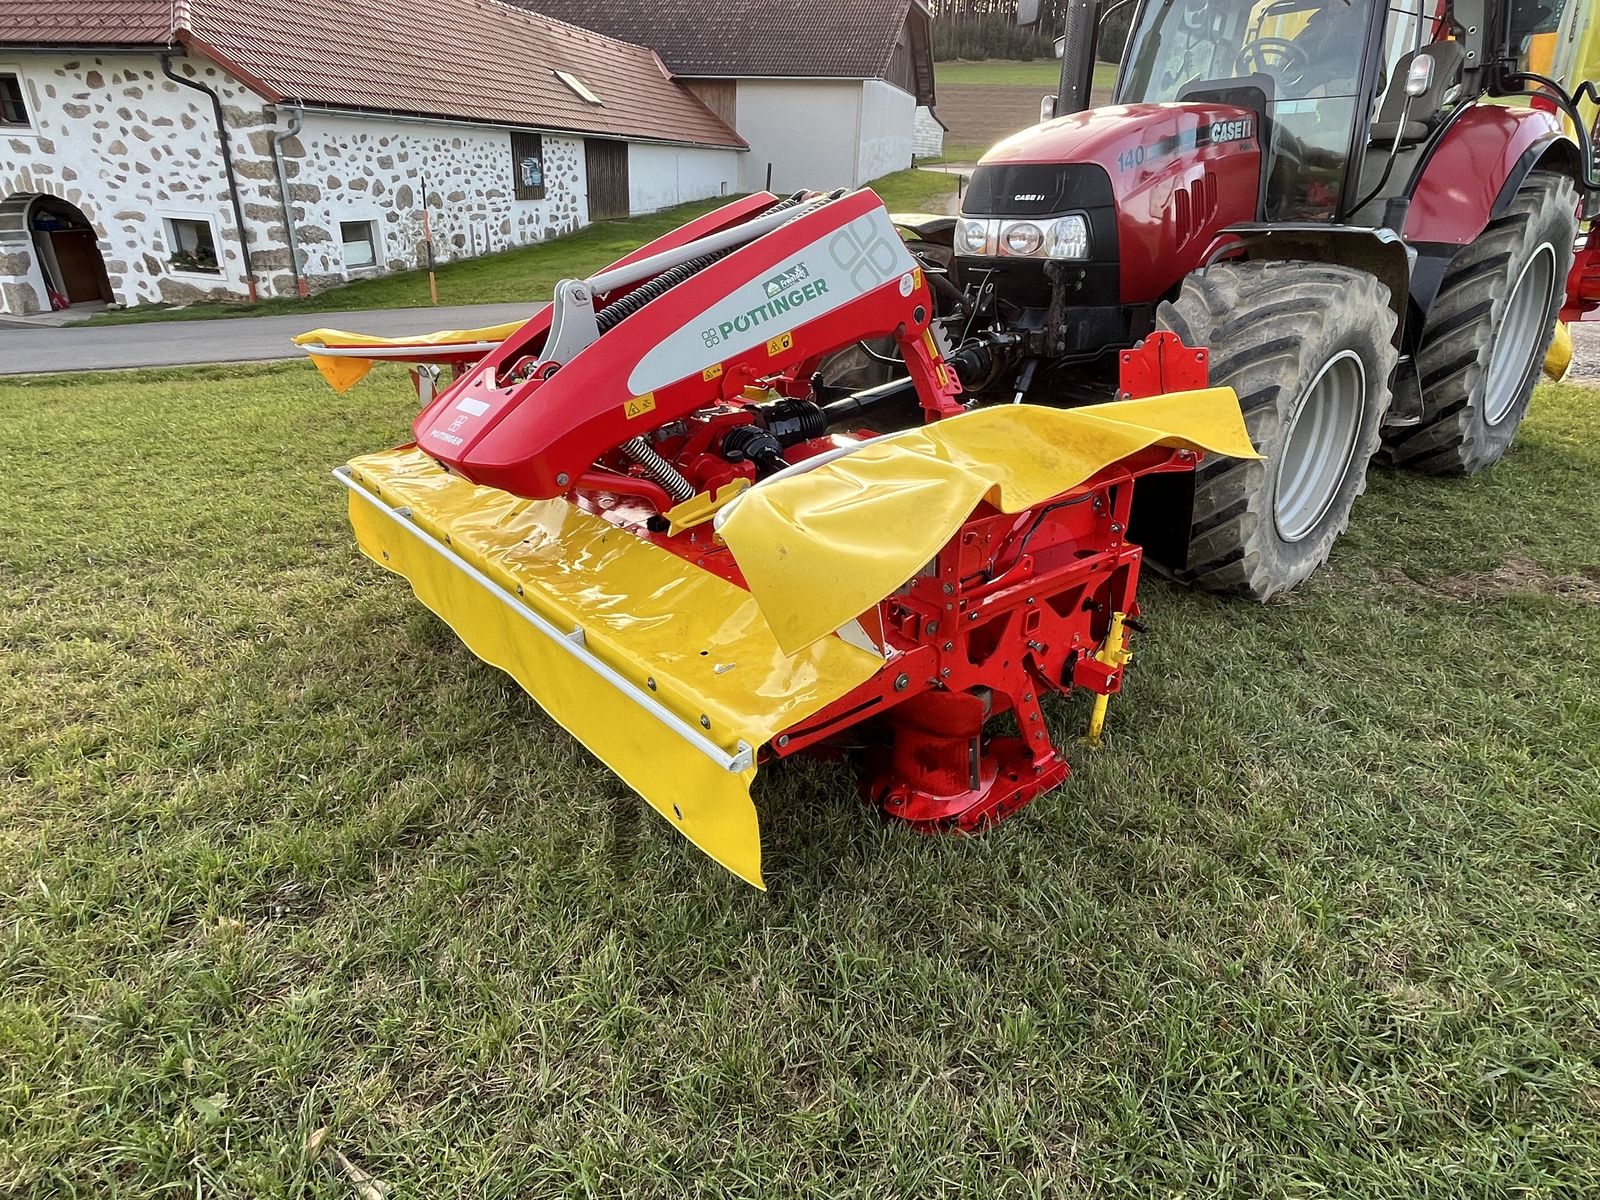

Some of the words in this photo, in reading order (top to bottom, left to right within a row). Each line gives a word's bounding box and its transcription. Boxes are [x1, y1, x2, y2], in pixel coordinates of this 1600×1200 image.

[1211, 121, 1242, 143] CASE
[1117, 145, 1145, 172] 140
[718, 278, 830, 341] PÖTTINGER
